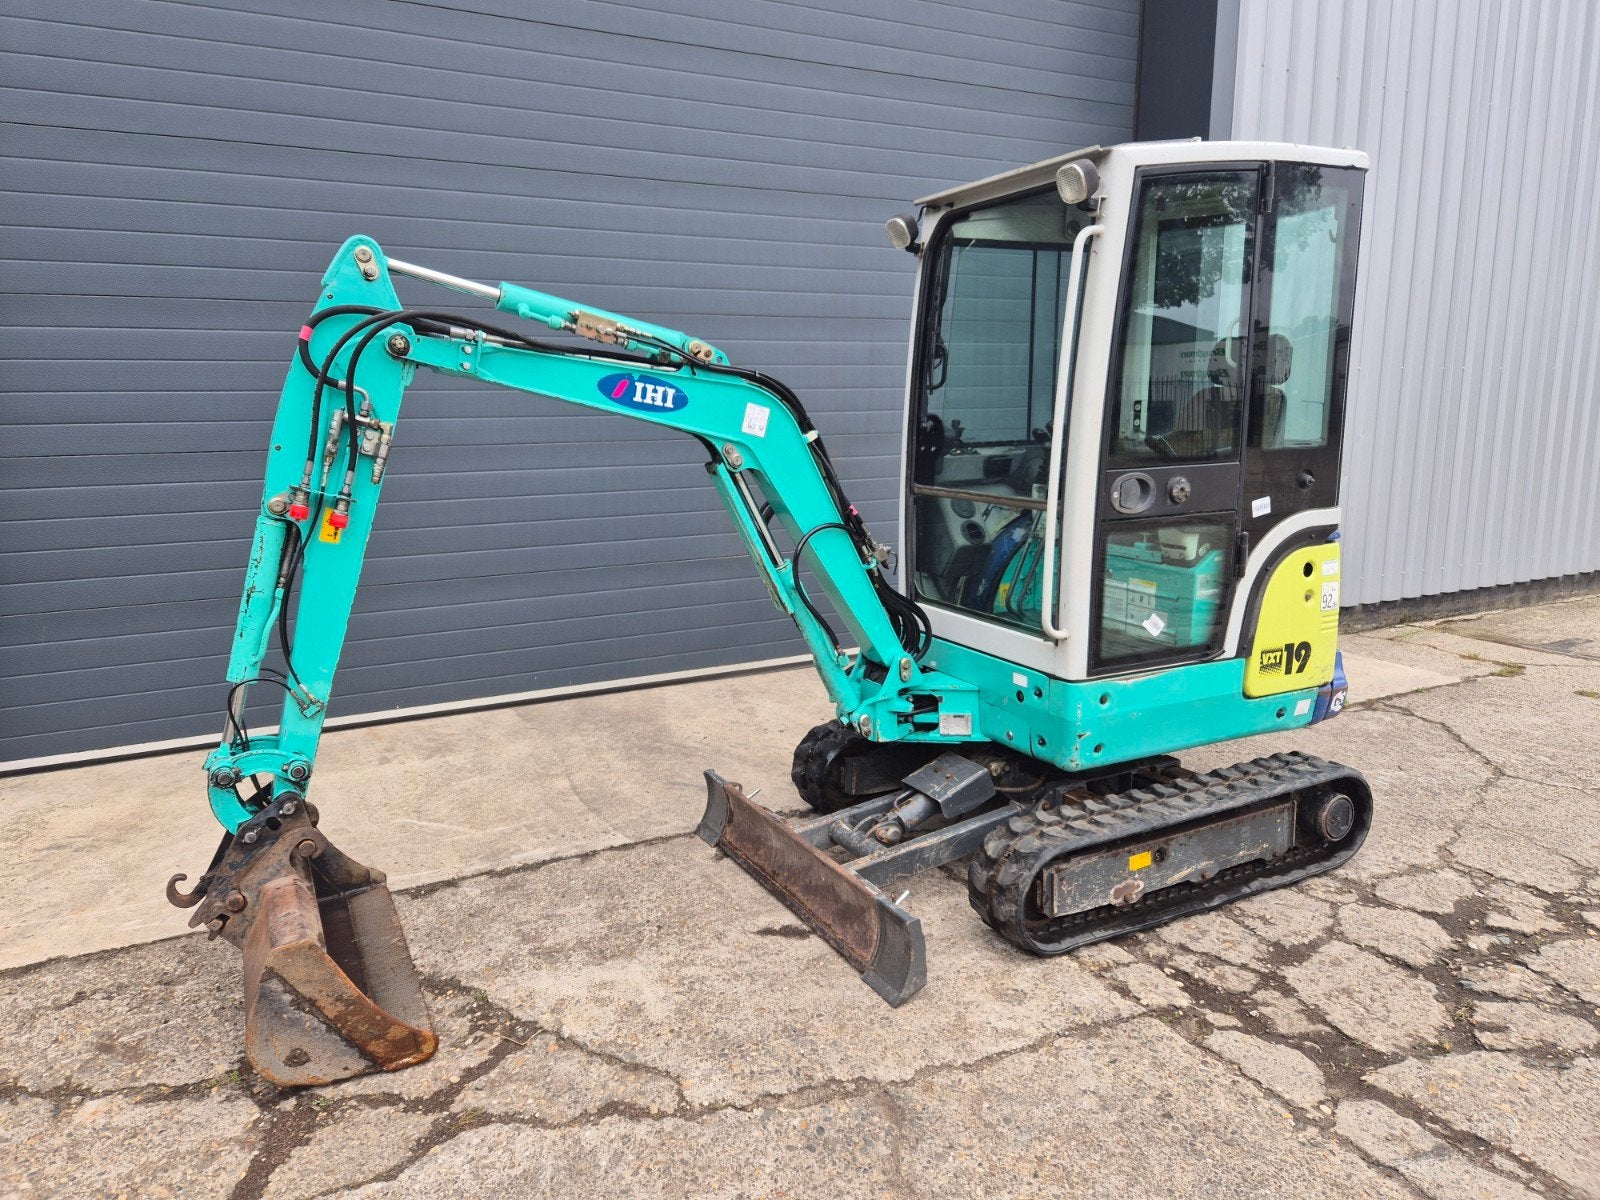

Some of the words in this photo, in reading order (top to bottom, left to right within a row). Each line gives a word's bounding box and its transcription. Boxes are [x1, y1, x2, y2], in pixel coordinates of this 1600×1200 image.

[633, 381, 675, 408] IHI
[1261, 650, 1282, 665] VXT
[1284, 641, 1311, 675] 19
